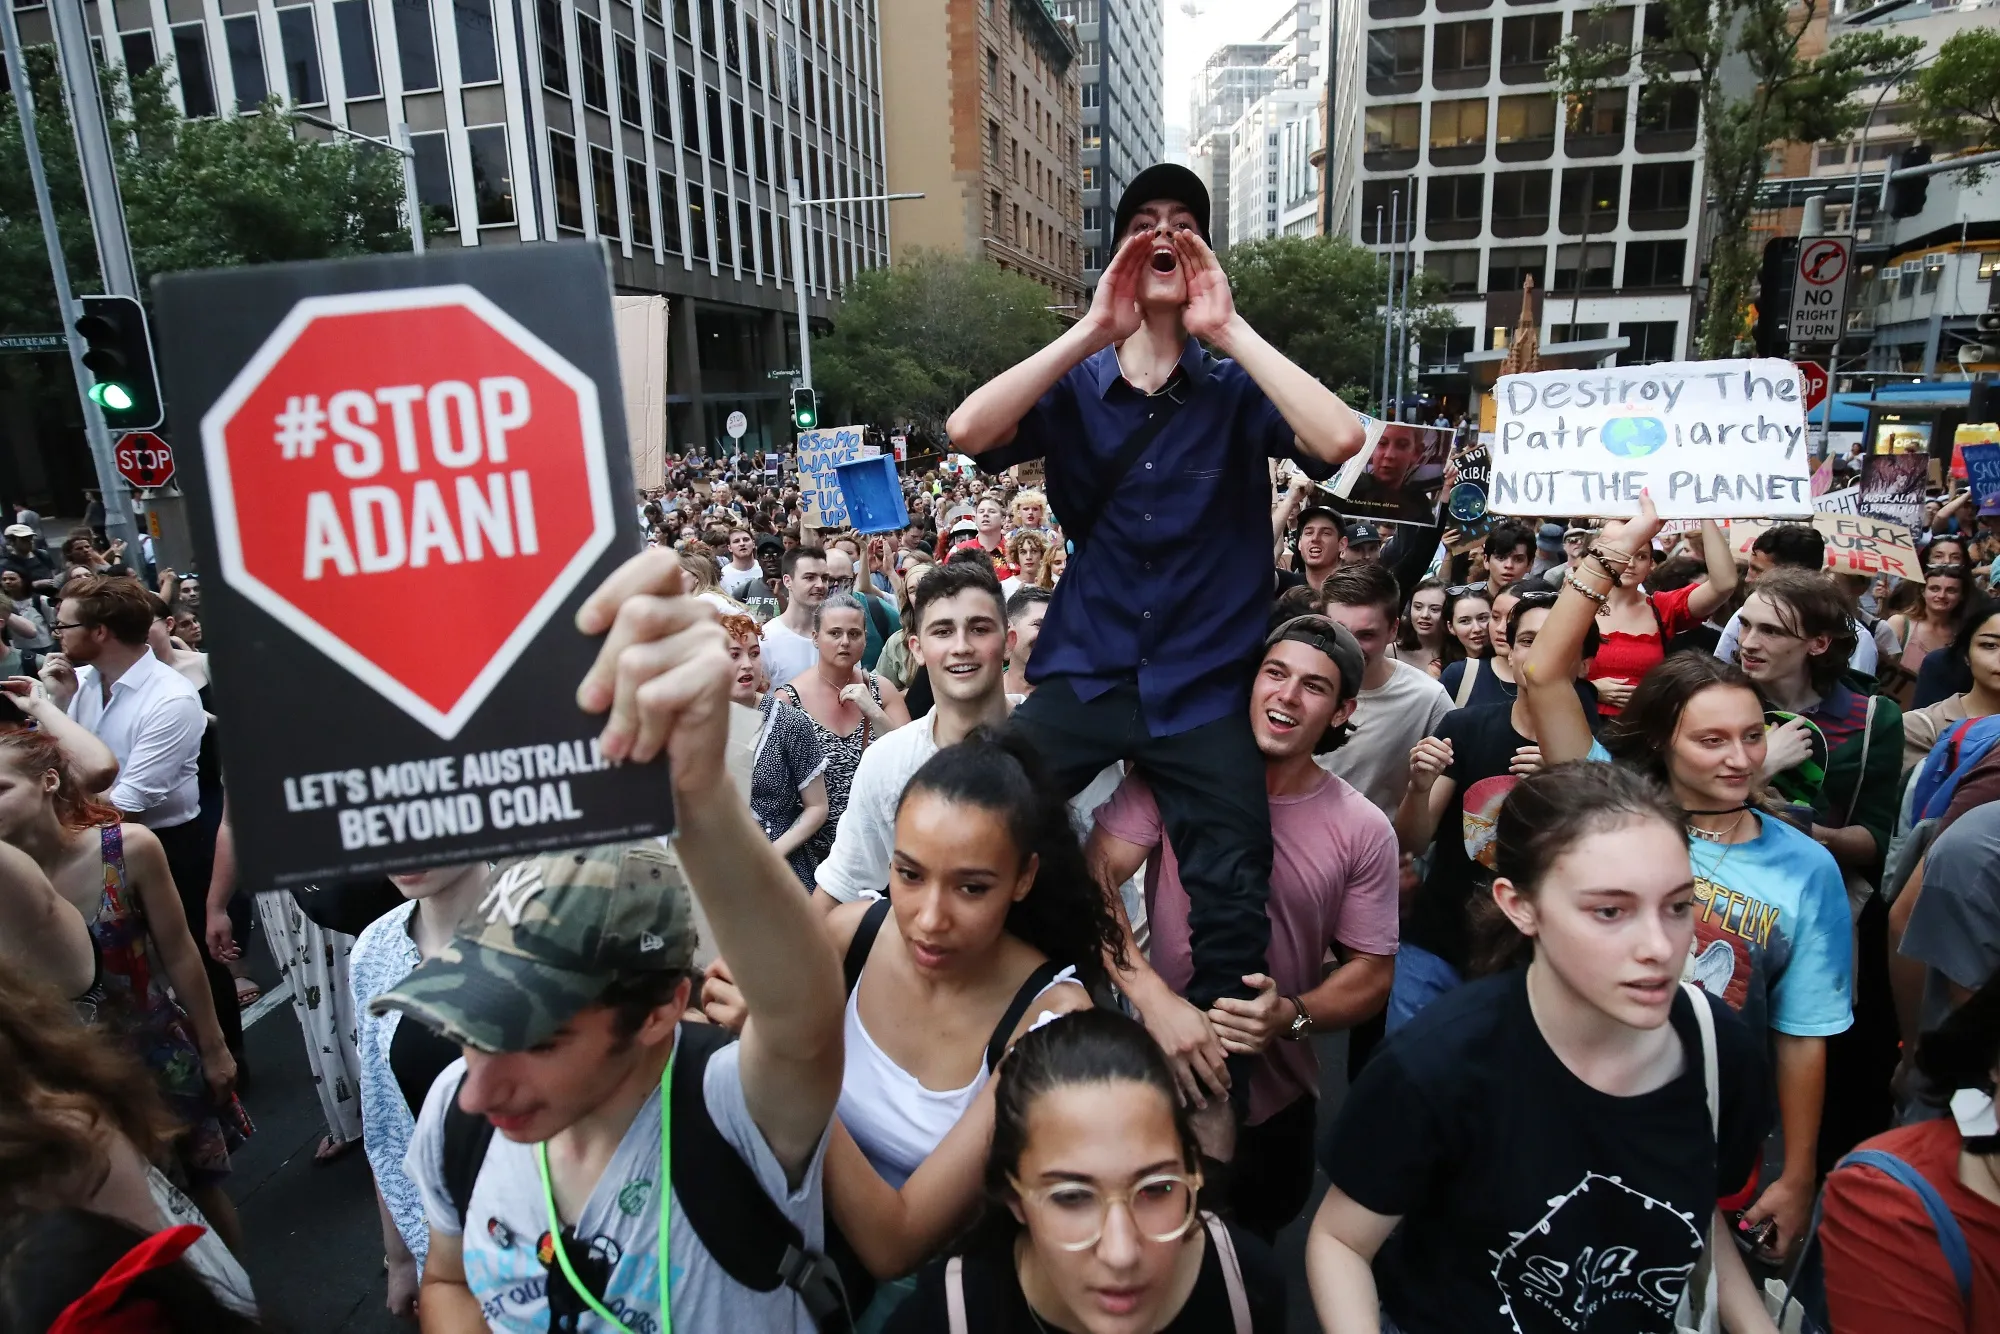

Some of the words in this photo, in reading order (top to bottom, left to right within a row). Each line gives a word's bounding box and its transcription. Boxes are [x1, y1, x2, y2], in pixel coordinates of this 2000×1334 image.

[1804, 289, 1833, 306] NO
[1796, 309, 1838, 321] RIGHT
[1796, 324, 1834, 336] TURN
[0, 336, 57, 347] ASTLEREAGH
[1507, 376, 1685, 416] Destroy
[1704, 370, 1799, 402] The
[274, 377, 531, 479] #STOP
[120, 450, 170, 470] STOP
[798, 448, 860, 473] WAKE
[1465, 446, 1486, 462] NOT
[1454, 466, 1491, 484] NCIBLE
[1494, 471, 1564, 505] NOT
[1569, 470, 1648, 504] THE
[1668, 470, 1809, 504] PLANET
[1863, 493, 1918, 503] AUSTRALIA
[802, 490, 846, 512] FUC
[1860, 504, 1869, 512] IS
[303, 470, 539, 581] ADANI
[821, 510, 847, 526] UP
[1682, 519, 1701, 530] FIR
[1837, 519, 1913, 548] FUCK
[1826, 546, 1908, 577] HER
[283, 768, 369, 812] LET'S
[370, 756, 459, 799] MOVE
[462, 737, 622, 788] AUSTRALI
[338, 793, 483, 851] BEYOND
[489, 780, 583, 831] COAL
[1523, 1287, 1579, 1332] SCHOOL
[1611, 1290, 1674, 1320] CLIMATE
